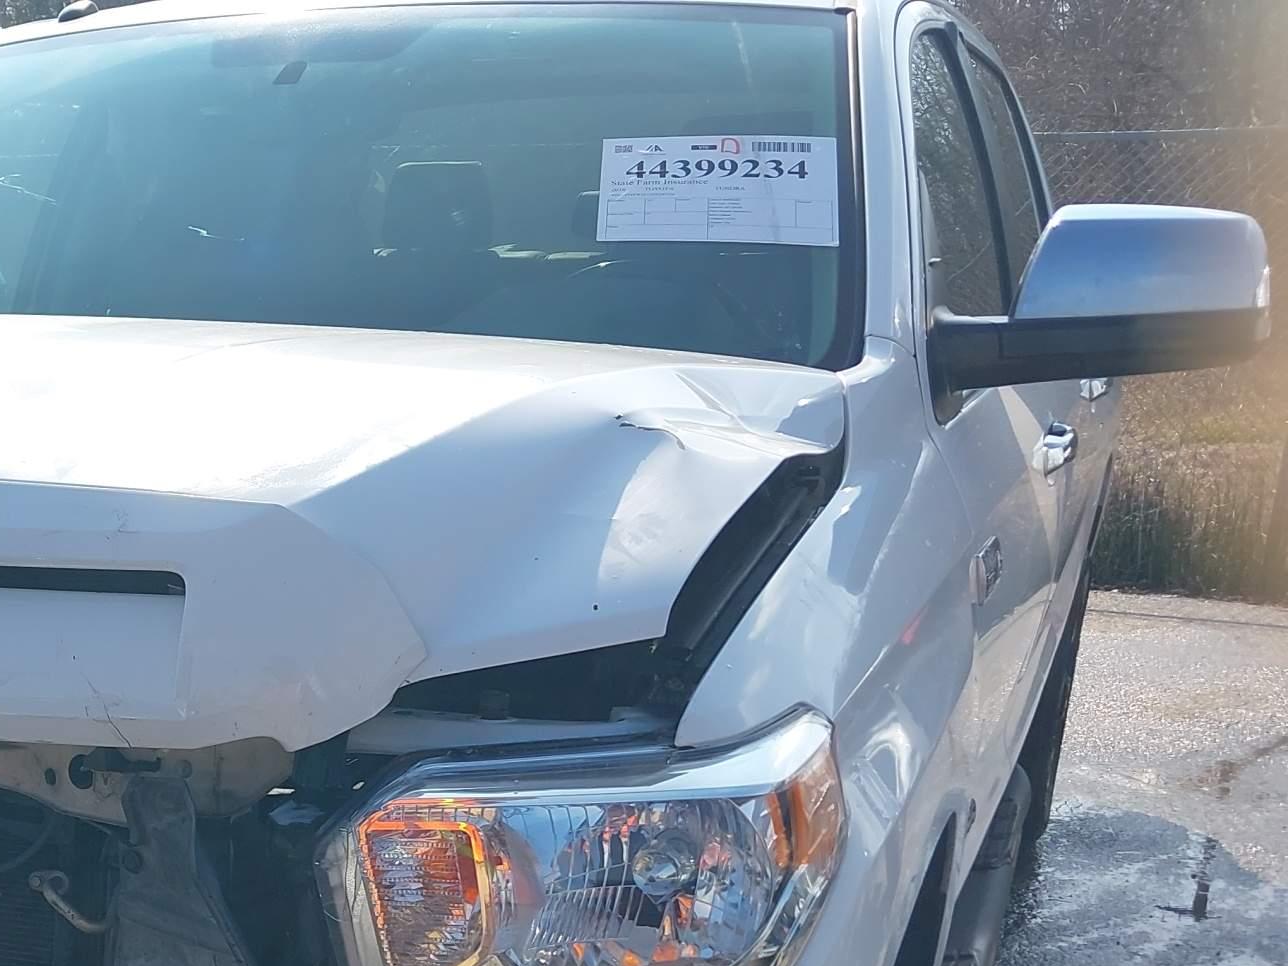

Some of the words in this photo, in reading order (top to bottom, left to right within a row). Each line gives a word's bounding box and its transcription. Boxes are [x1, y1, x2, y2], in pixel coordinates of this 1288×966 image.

[626, 159, 809, 179] 44399234
[611, 179, 634, 187] State
[664, 178, 709, 186] Insurance
